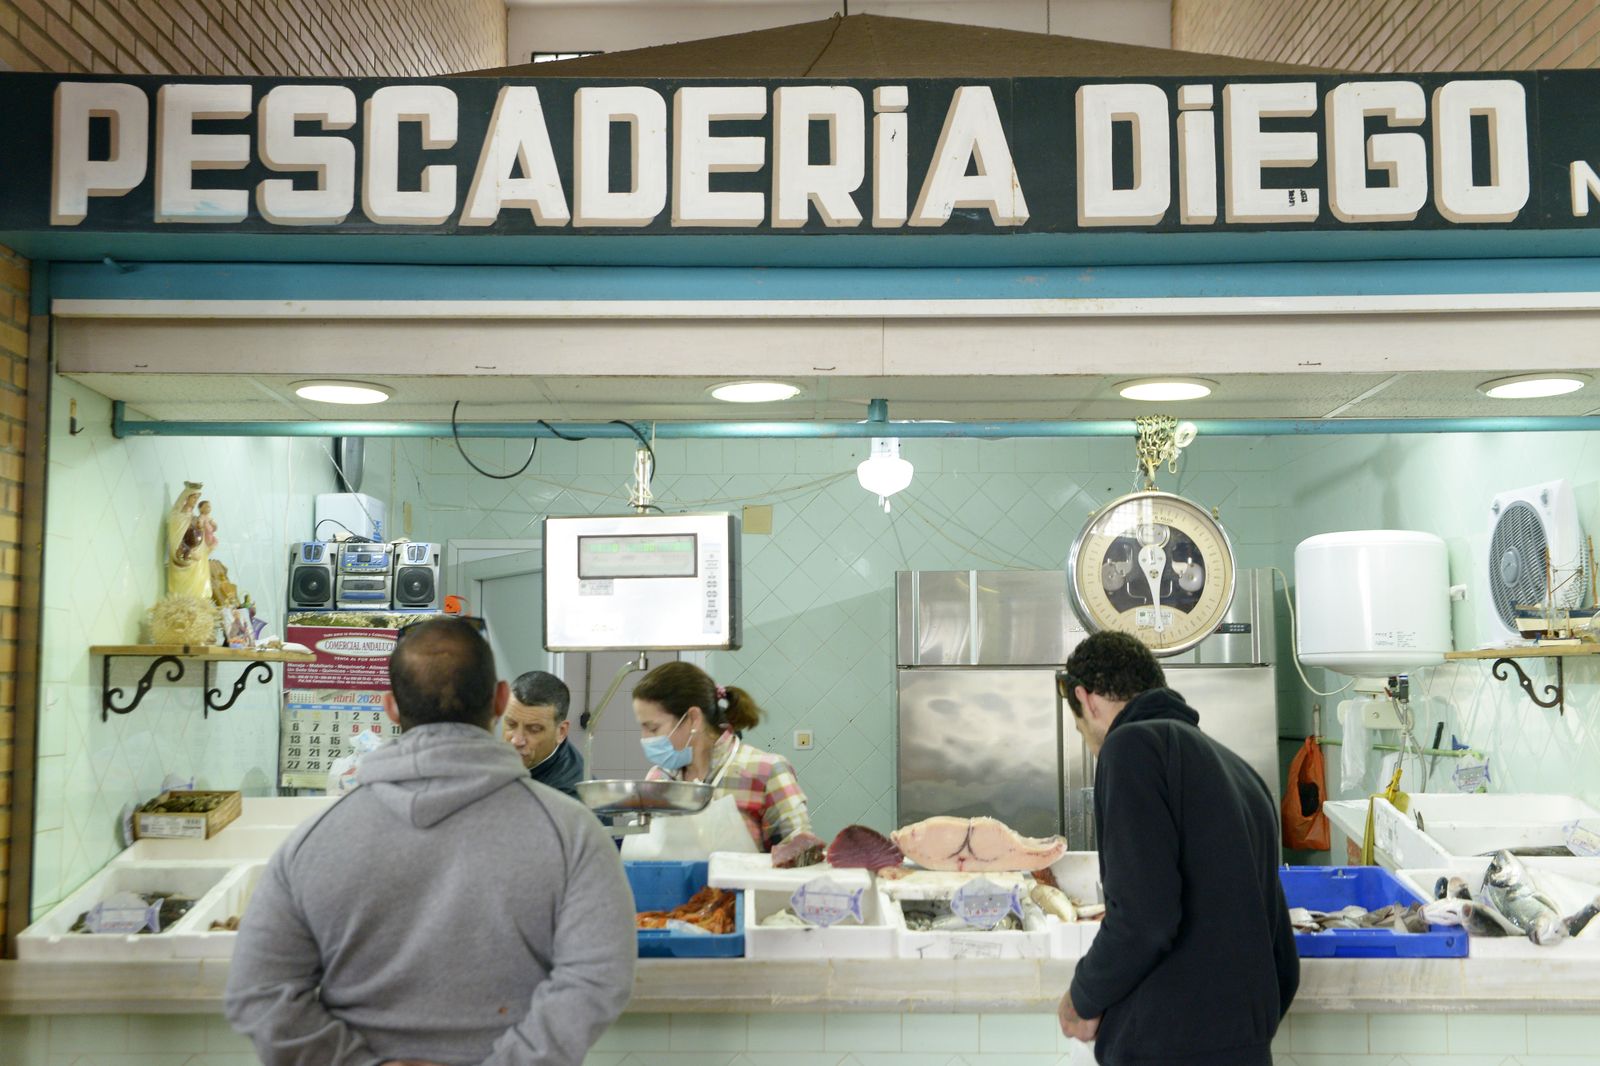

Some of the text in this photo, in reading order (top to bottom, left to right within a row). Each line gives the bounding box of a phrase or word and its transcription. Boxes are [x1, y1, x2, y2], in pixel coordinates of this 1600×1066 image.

[324, 640, 361, 651] COMERCIAL
[357, 694, 382, 704] 2020
[334, 711, 380, 721] 1 2 3
[292, 722, 400, 734] 6 7 8 9 10 11
[290, 735, 340, 745] 13 14 15
[288, 748, 301, 757] 20
[308, 748, 320, 757] 21
[327, 749, 341, 758] 22
[287, 760, 300, 769] 27
[307, 761, 320, 770] 28
